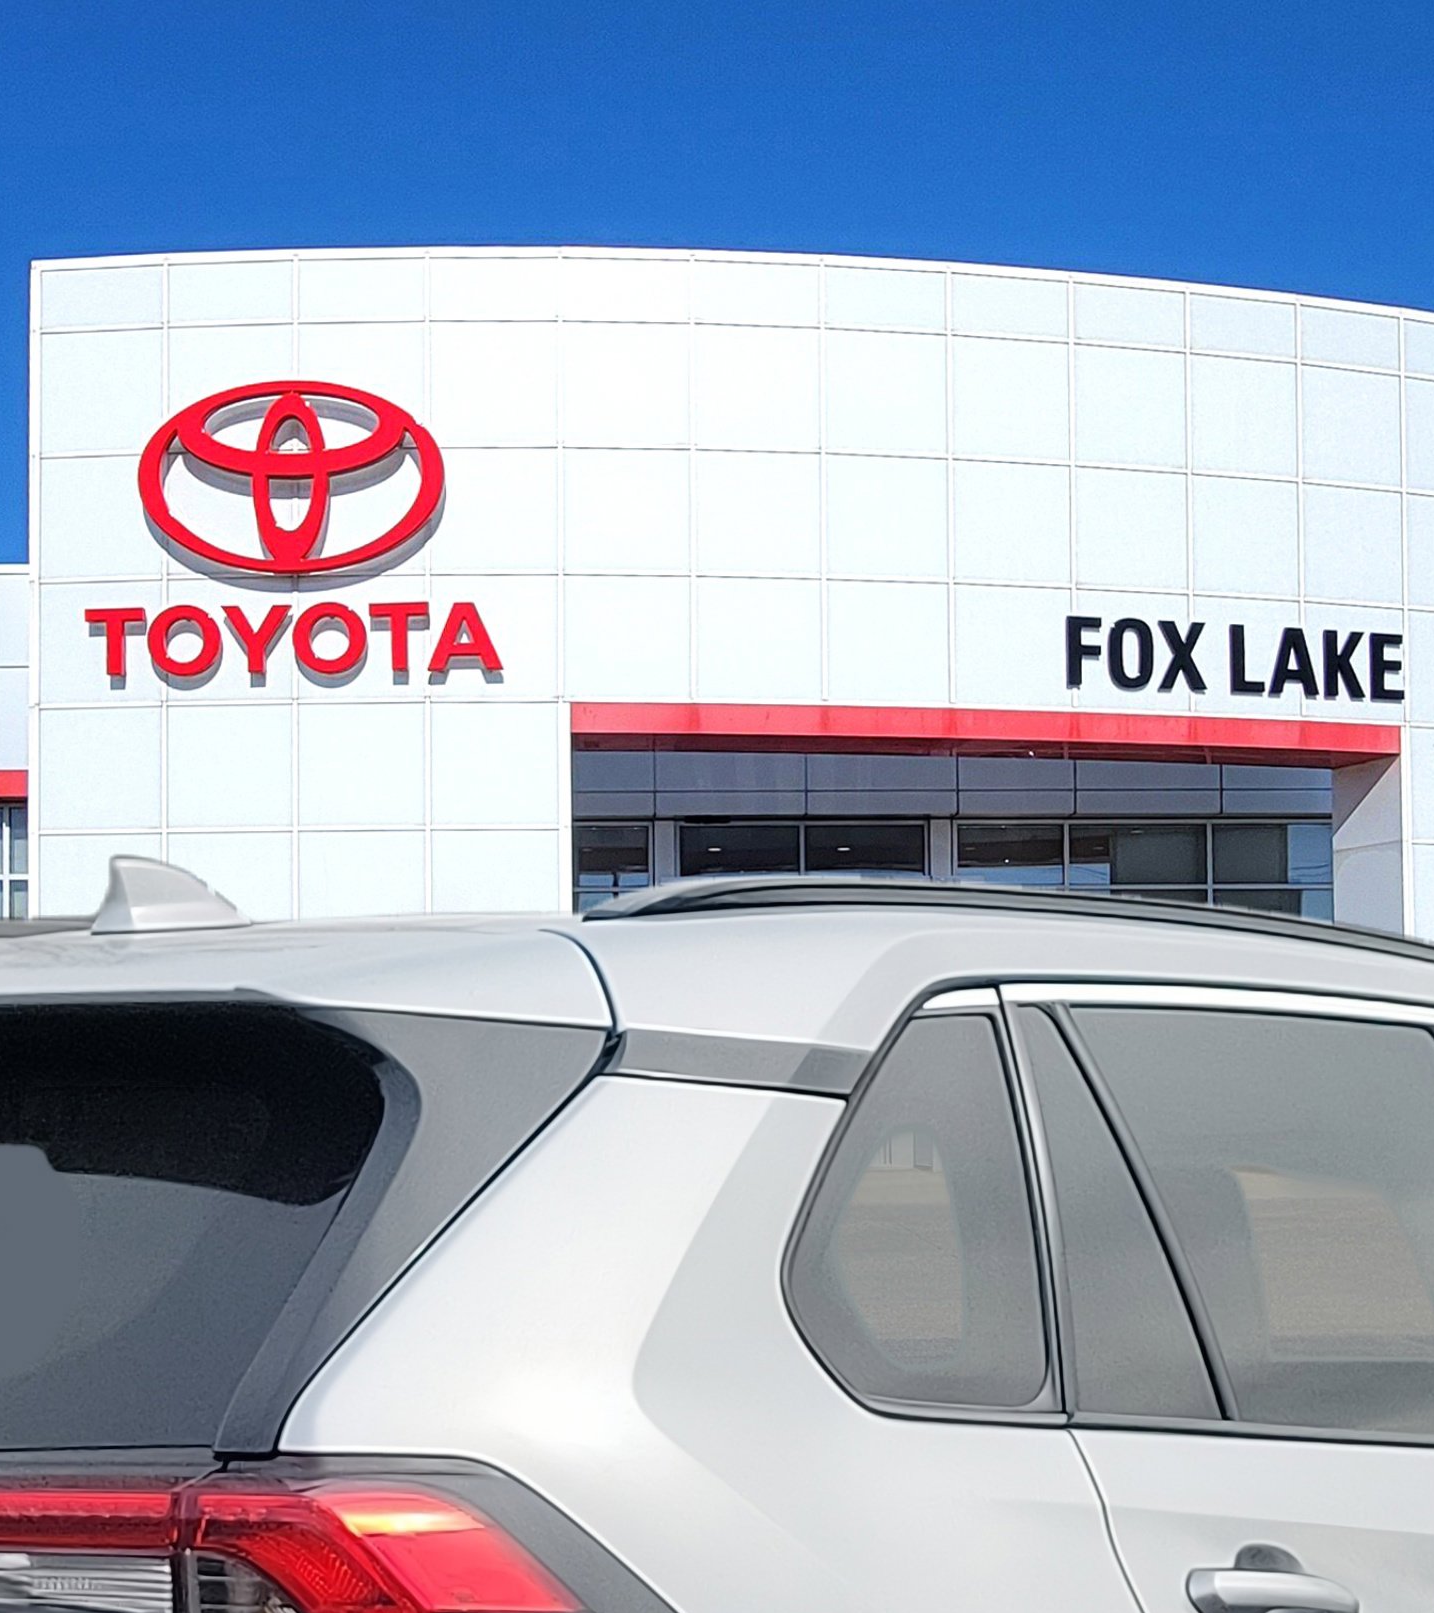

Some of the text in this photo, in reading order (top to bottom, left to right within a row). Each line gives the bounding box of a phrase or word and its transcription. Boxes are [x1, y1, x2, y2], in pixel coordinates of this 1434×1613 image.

[85, 602, 504, 690] TOYOTA
[1066, 615, 1405, 702] FOX LAKE
